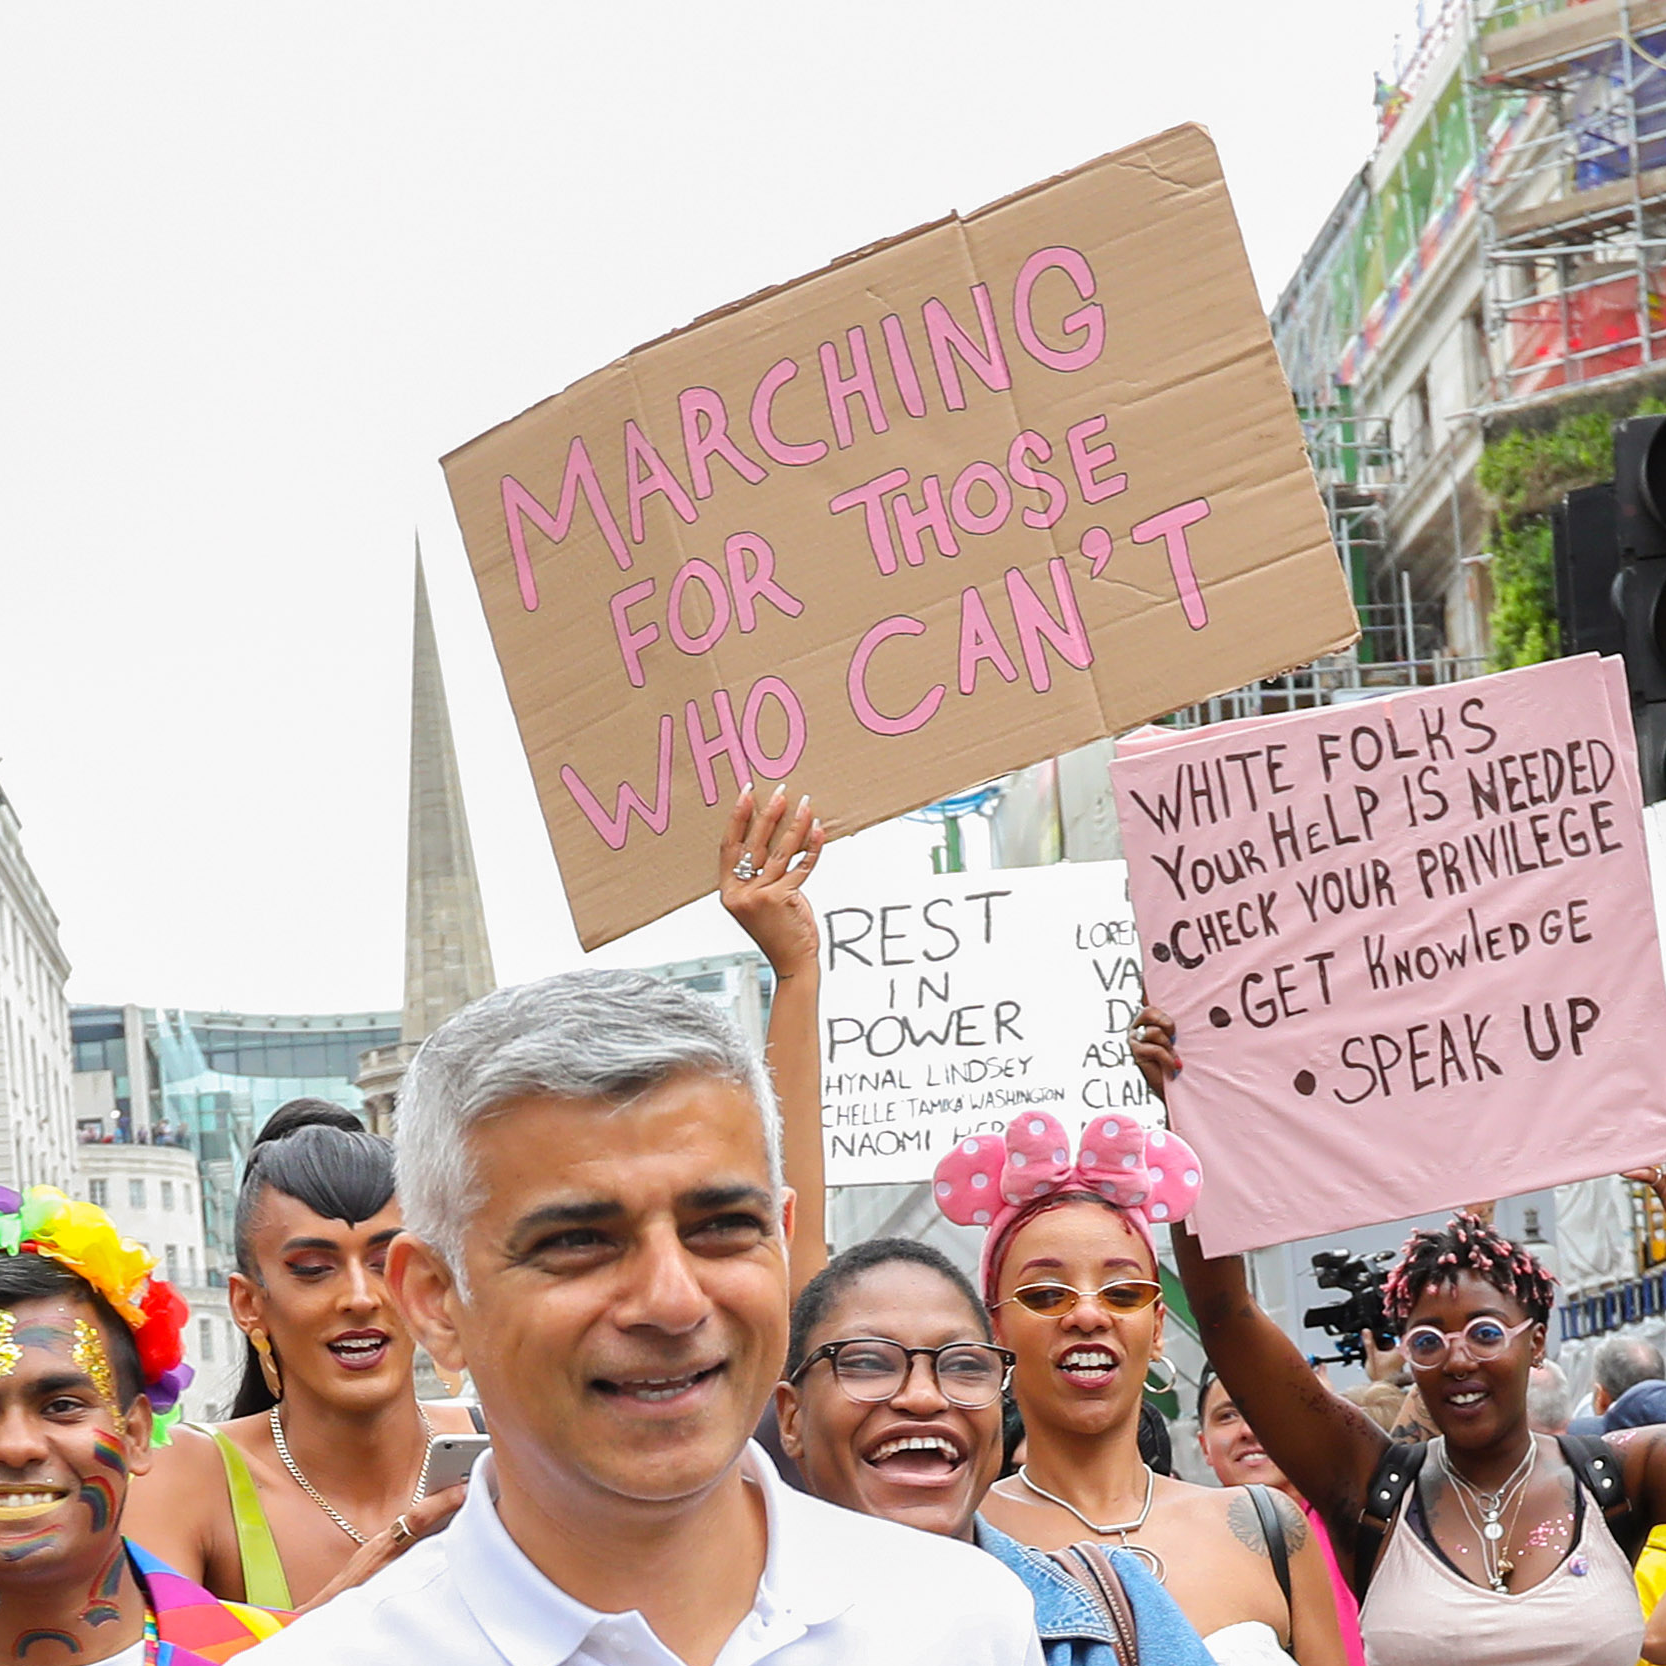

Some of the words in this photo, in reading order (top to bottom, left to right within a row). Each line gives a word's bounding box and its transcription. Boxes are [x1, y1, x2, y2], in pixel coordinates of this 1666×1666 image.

[499, 246, 1107, 613] MARCHING
[608, 531, 804, 688] FOR
[829, 414, 1127, 576] THOSE
[560, 676, 807, 850] WHO
[846, 497, 1211, 736] CAN'T
[1129, 743, 1295, 836] WHITE
[1317, 697, 1498, 784] FOLKS
[1402, 765, 1451, 828] IS
[1465, 738, 1617, 821] NEEDED
[1169, 891, 1280, 972] CHECK
[1294, 858, 1398, 925] YOUR
[1415, 800, 1624, 900] PRIVILEGE
[823, 890, 1013, 971] REST
[827, 1000, 1025, 1063] POWER
[889, 971, 950, 1009] IN
[1239, 951, 1336, 1030] GET
[926, 1055, 1035, 1087] LINDSEY
[1333, 1012, 1504, 1105] SPEAK
[1522, 996, 1602, 1062] UP
[968, 1086, 1066, 1110] WASHINGTON
[831, 1128, 931, 1158] NAOMI
